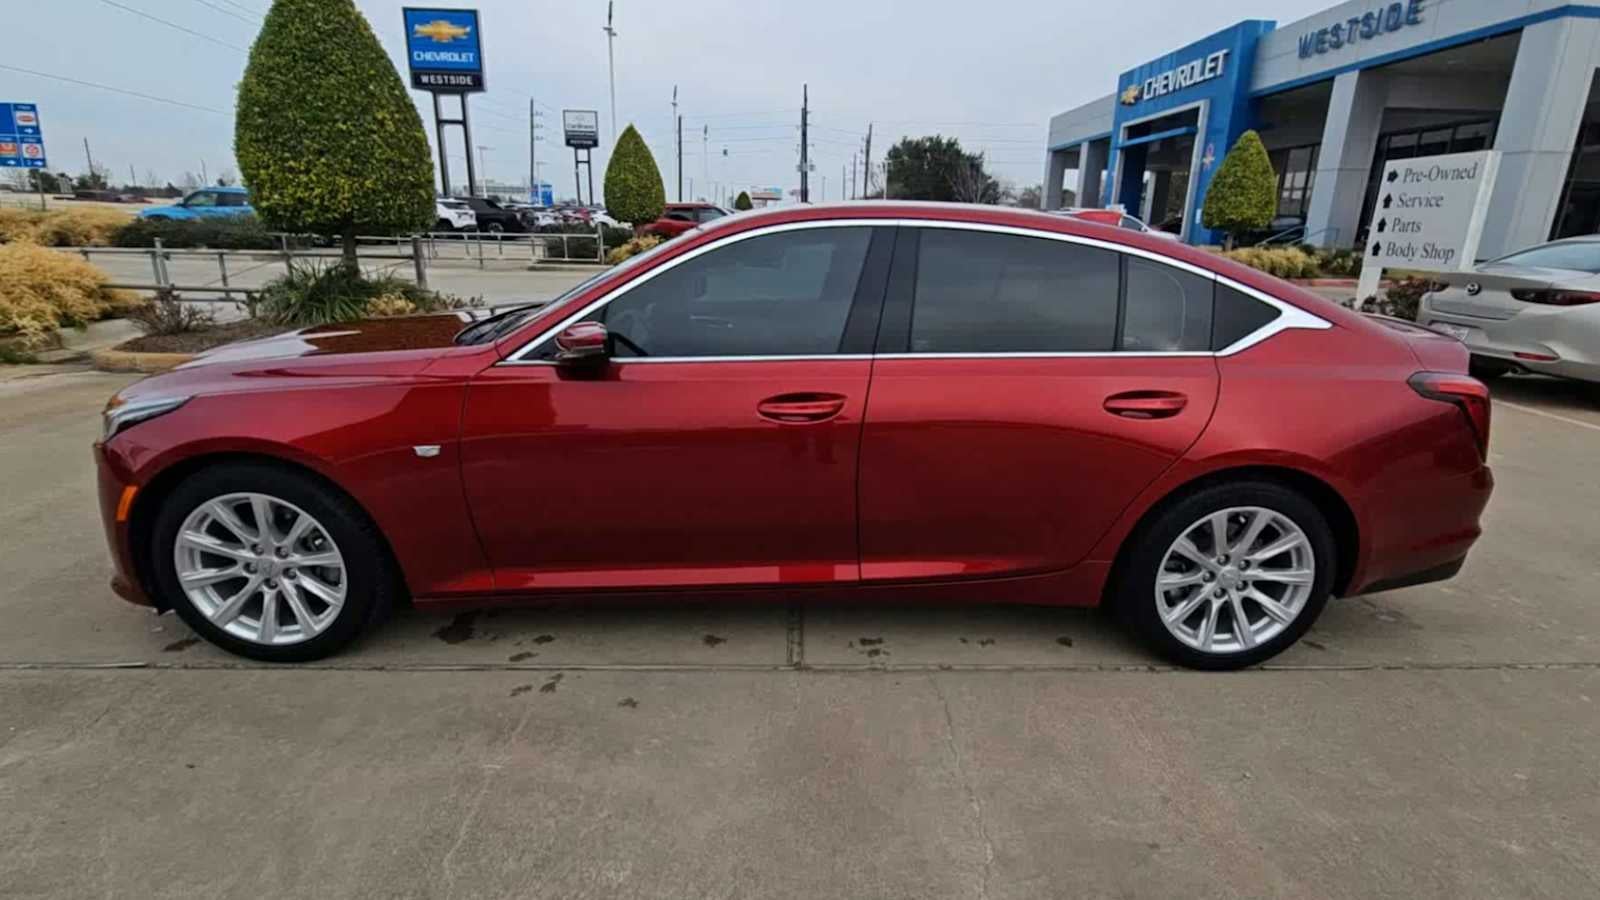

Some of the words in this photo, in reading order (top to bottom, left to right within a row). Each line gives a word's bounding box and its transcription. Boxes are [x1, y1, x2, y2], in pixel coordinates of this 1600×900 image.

[1298, 0, 1424, 59] WESTSIDE
[413, 51, 475, 63] CHEVROLET
[421, 75, 473, 86] WESTSIDE
[1143, 49, 1230, 101] CHEVROLET
[1403, 161, 1478, 184] Pre-Owned
[1396, 192, 1444, 208] Service
[1391, 217, 1423, 233] Parts
[1385, 242, 1418, 261] Body
[1420, 242, 1455, 264] Shop
